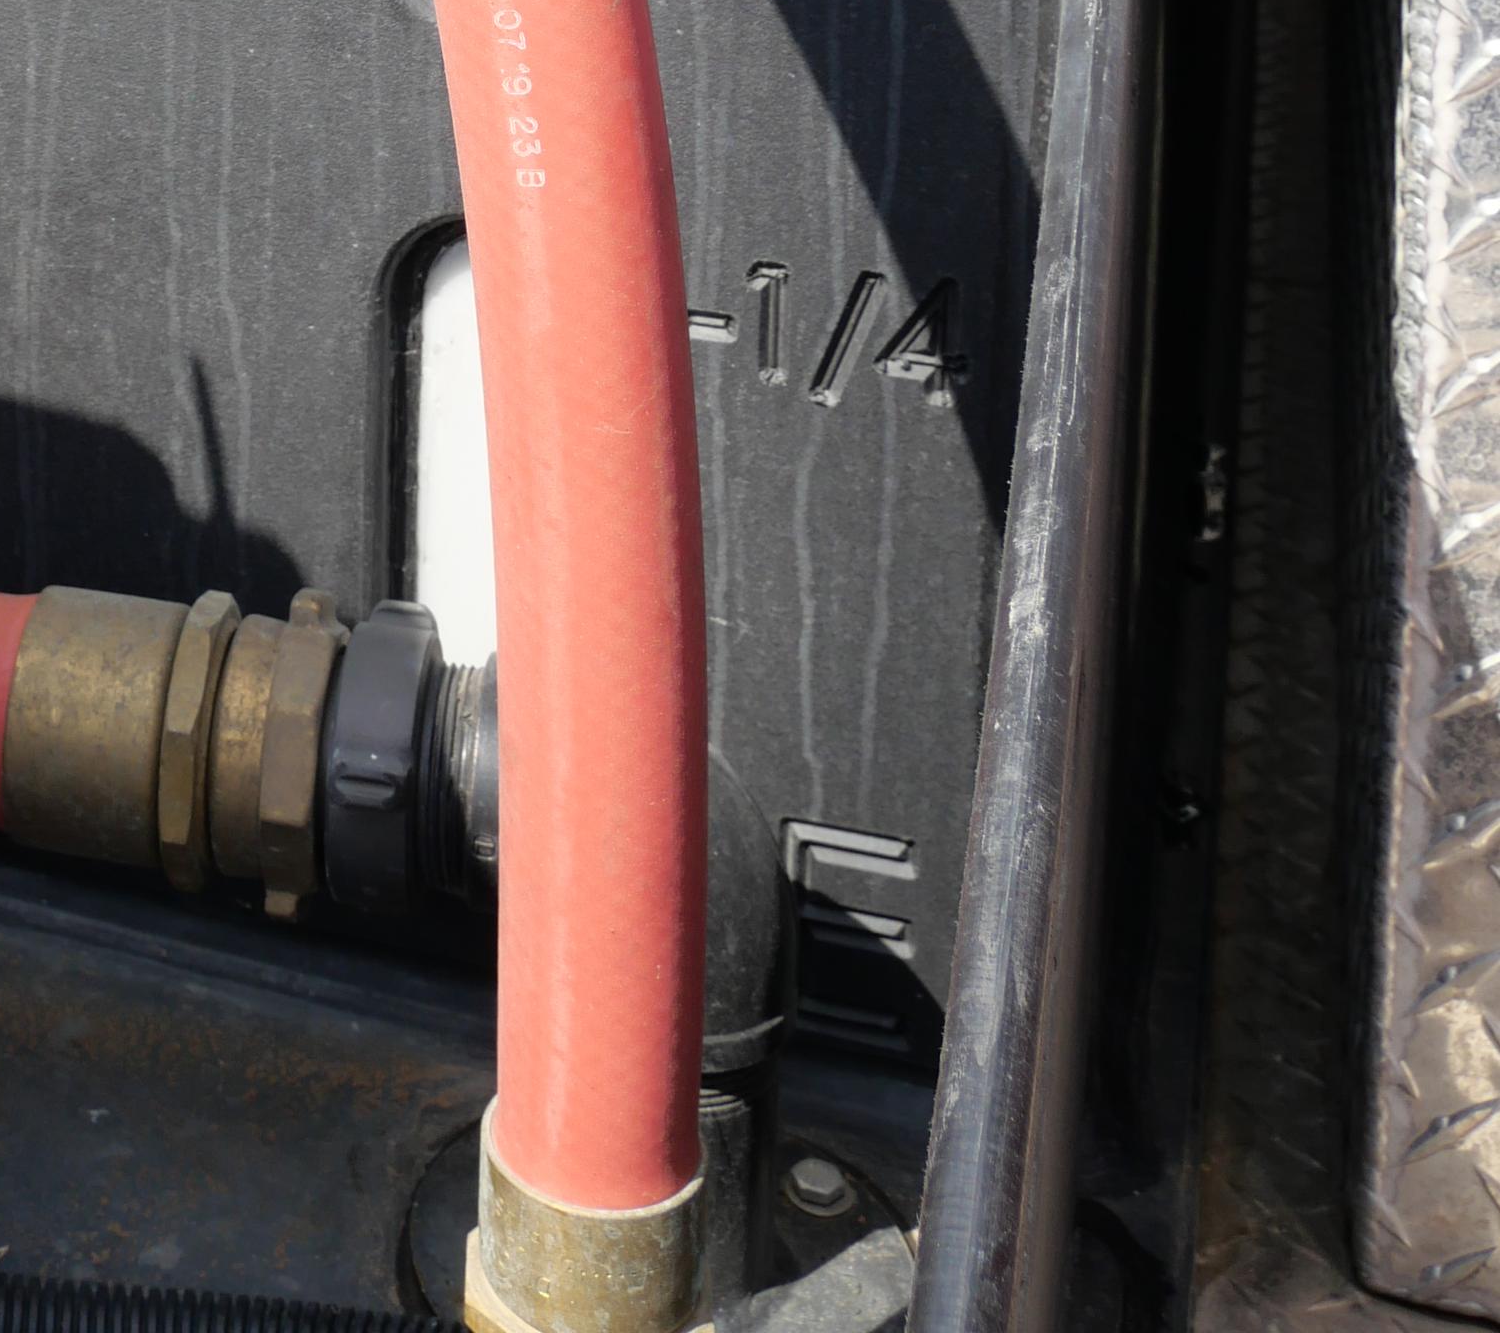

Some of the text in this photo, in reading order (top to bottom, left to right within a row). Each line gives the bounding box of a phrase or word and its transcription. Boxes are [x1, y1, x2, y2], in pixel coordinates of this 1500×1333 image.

[493, 8, 528, 51] 07
[508, 116, 543, 158] 23
[516, 167, 546, 188] B
[780, 816, 920, 1055] E
